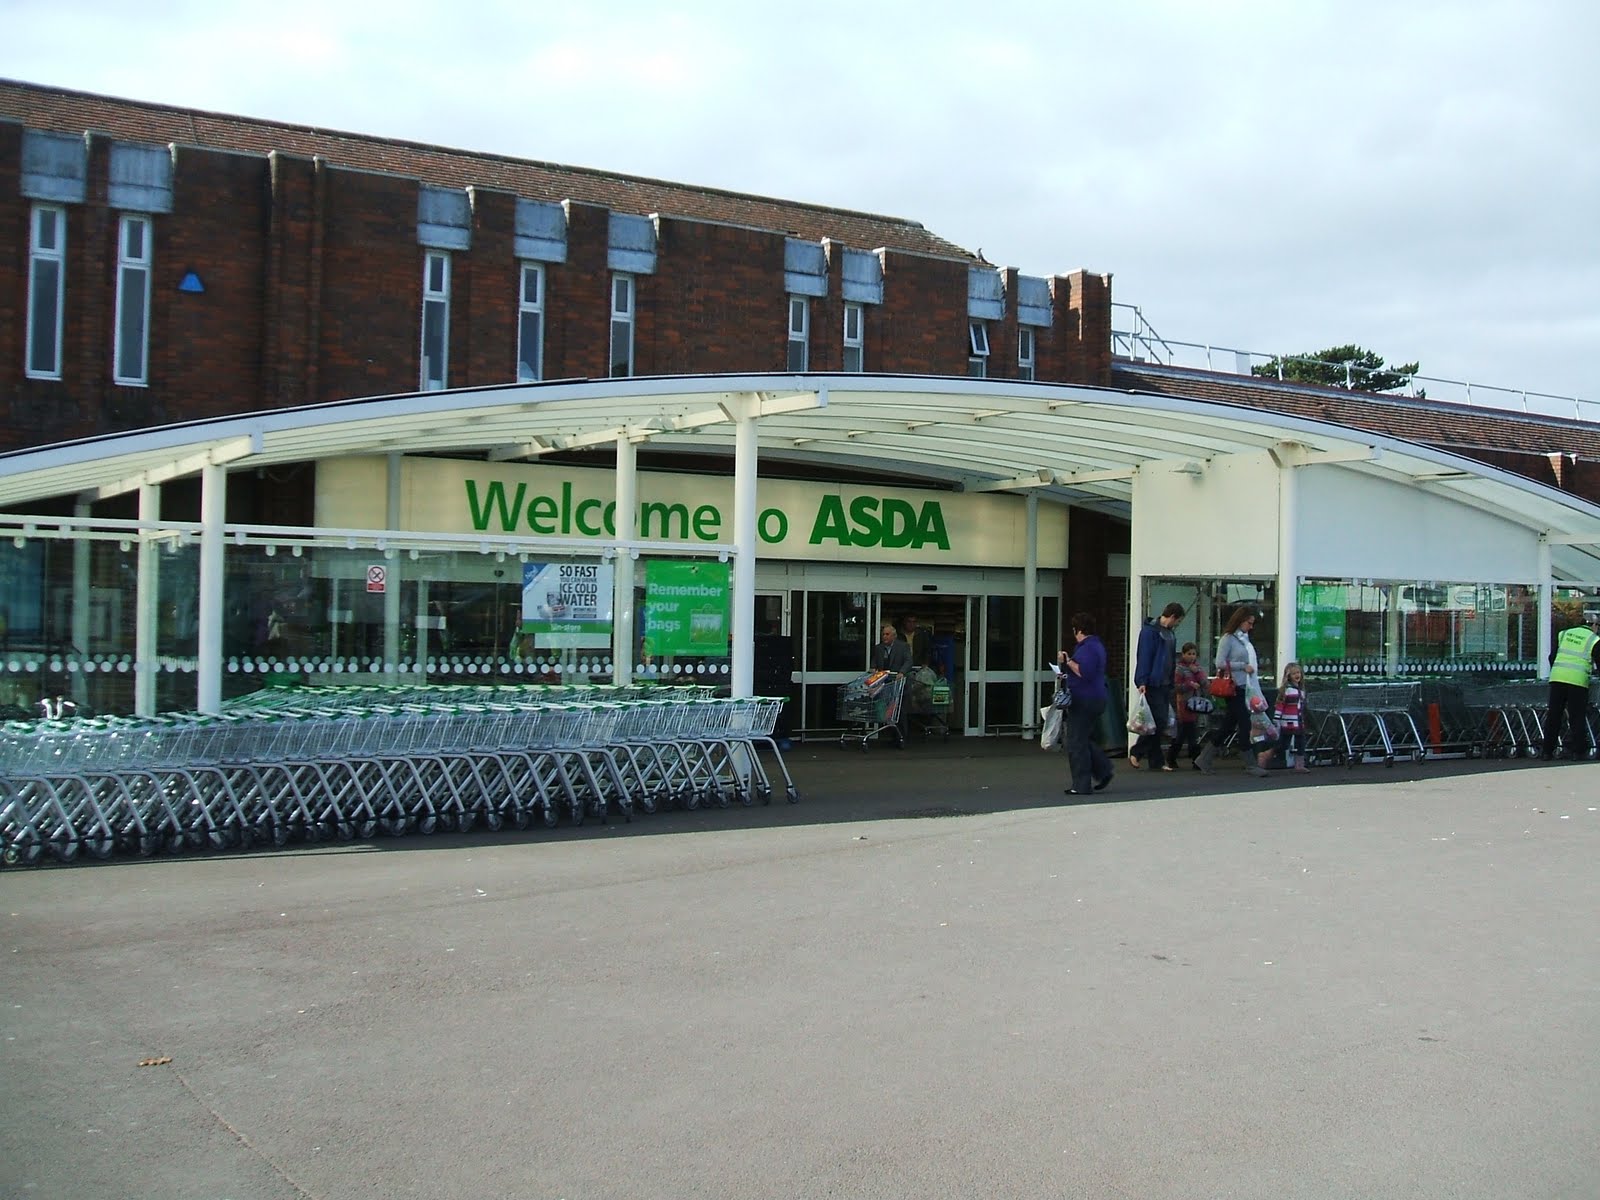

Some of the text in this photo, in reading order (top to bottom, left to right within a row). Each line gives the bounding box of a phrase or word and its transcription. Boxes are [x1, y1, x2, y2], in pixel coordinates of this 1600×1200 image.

[808, 494, 951, 550] ASDA
[560, 565, 598, 577] SO FAST
[560, 583, 598, 594] ICE COLD
[648, 583, 723, 597] Remember
[560, 594, 597, 606] WATER
[647, 602, 680, 614] your
